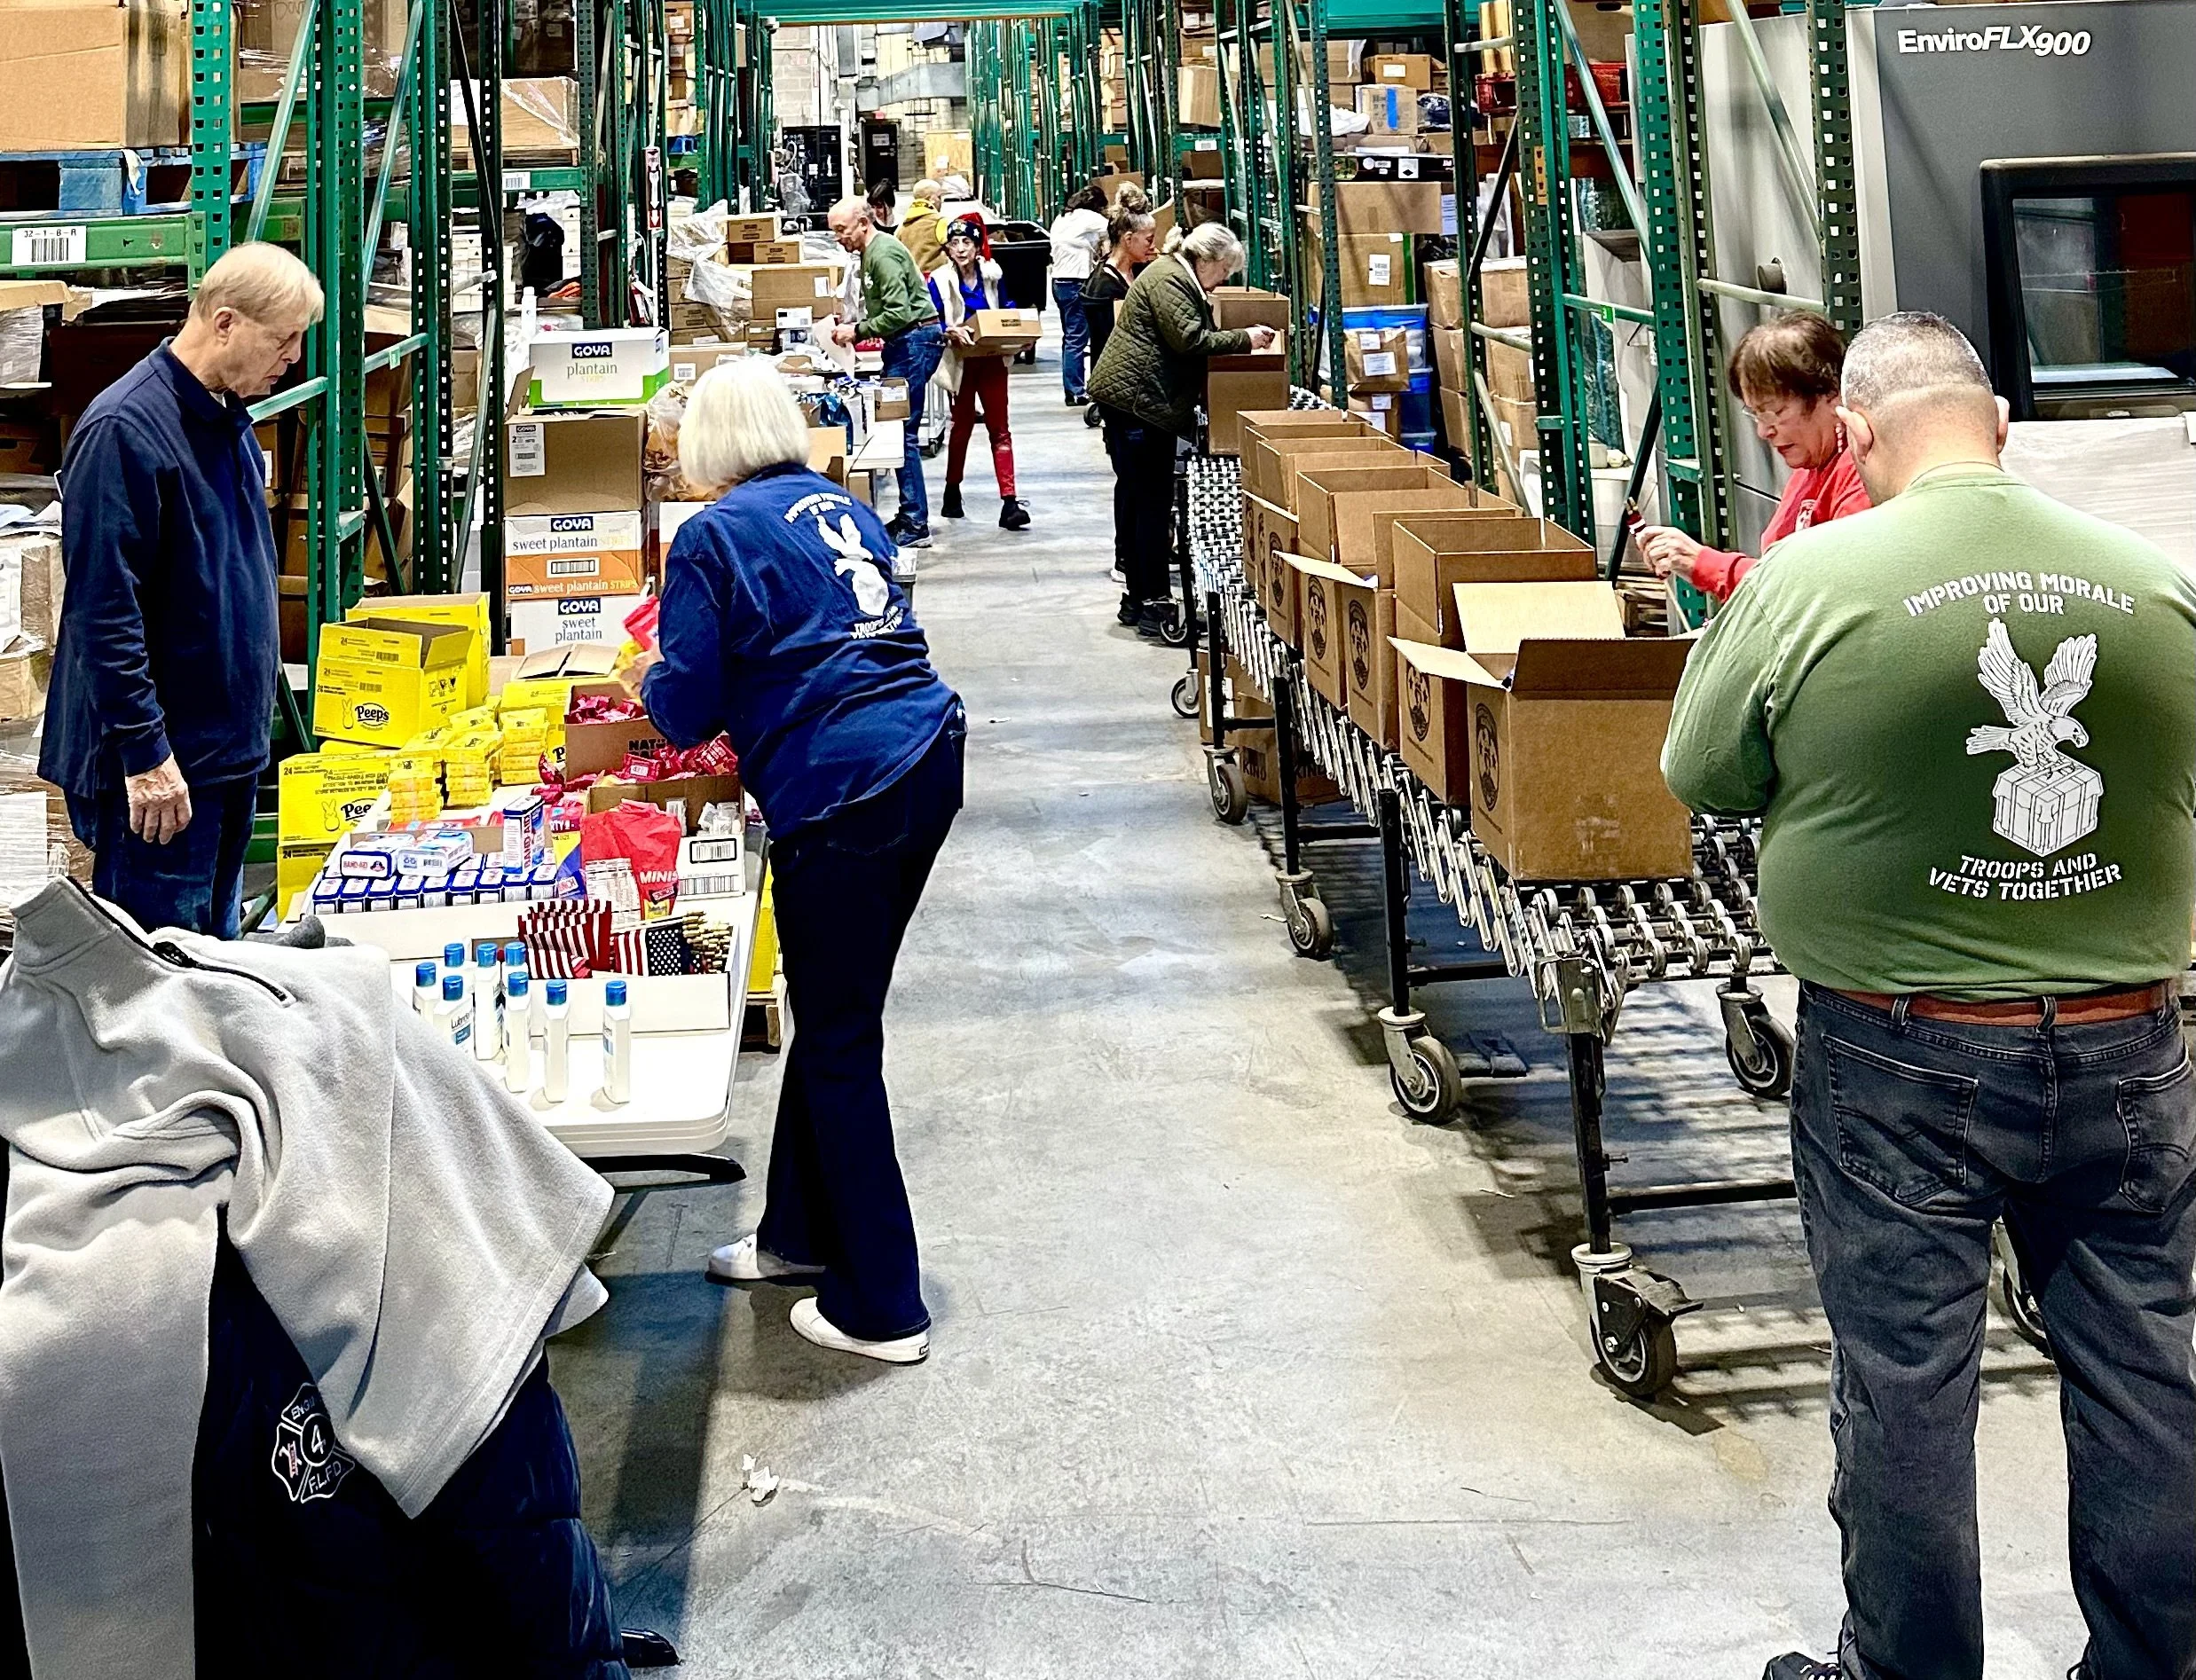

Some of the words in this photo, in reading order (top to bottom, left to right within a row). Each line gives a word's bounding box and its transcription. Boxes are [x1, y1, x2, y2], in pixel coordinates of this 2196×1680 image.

[1897, 25, 2092, 56] EnviroFLX900
[573, 344, 611, 357] GOYA
[567, 362, 618, 380] plantain
[552, 517, 592, 531] GOYA
[513, 538, 547, 551] sweet
[549, 535, 597, 552] plantain
[508, 585, 533, 593] GOYA
[533, 582, 563, 594] sweet
[566, 579, 609, 595] plantain
[1902, 571, 2034, 617] IMPROVING
[2039, 572, 2136, 615] MORALE
[559, 600, 600, 614] GOYA
[1983, 593, 2011, 614] OF
[2019, 593, 2065, 615] OUR
[562, 616, 595, 629] sweet
[555, 628, 602, 644] plantain
[355, 705, 390, 721] Peeps
[283, 766, 293, 775] 24
[341, 803, 372, 819] Pee
[1959, 855, 2045, 881] TROOPS
[2051, 852, 2098, 877] AND
[639, 870, 679, 884] MINIS
[1928, 867, 1991, 899] VETS
[1998, 863, 2122, 900] TOGETHER
[311, 1425, 327, 1455] 4
